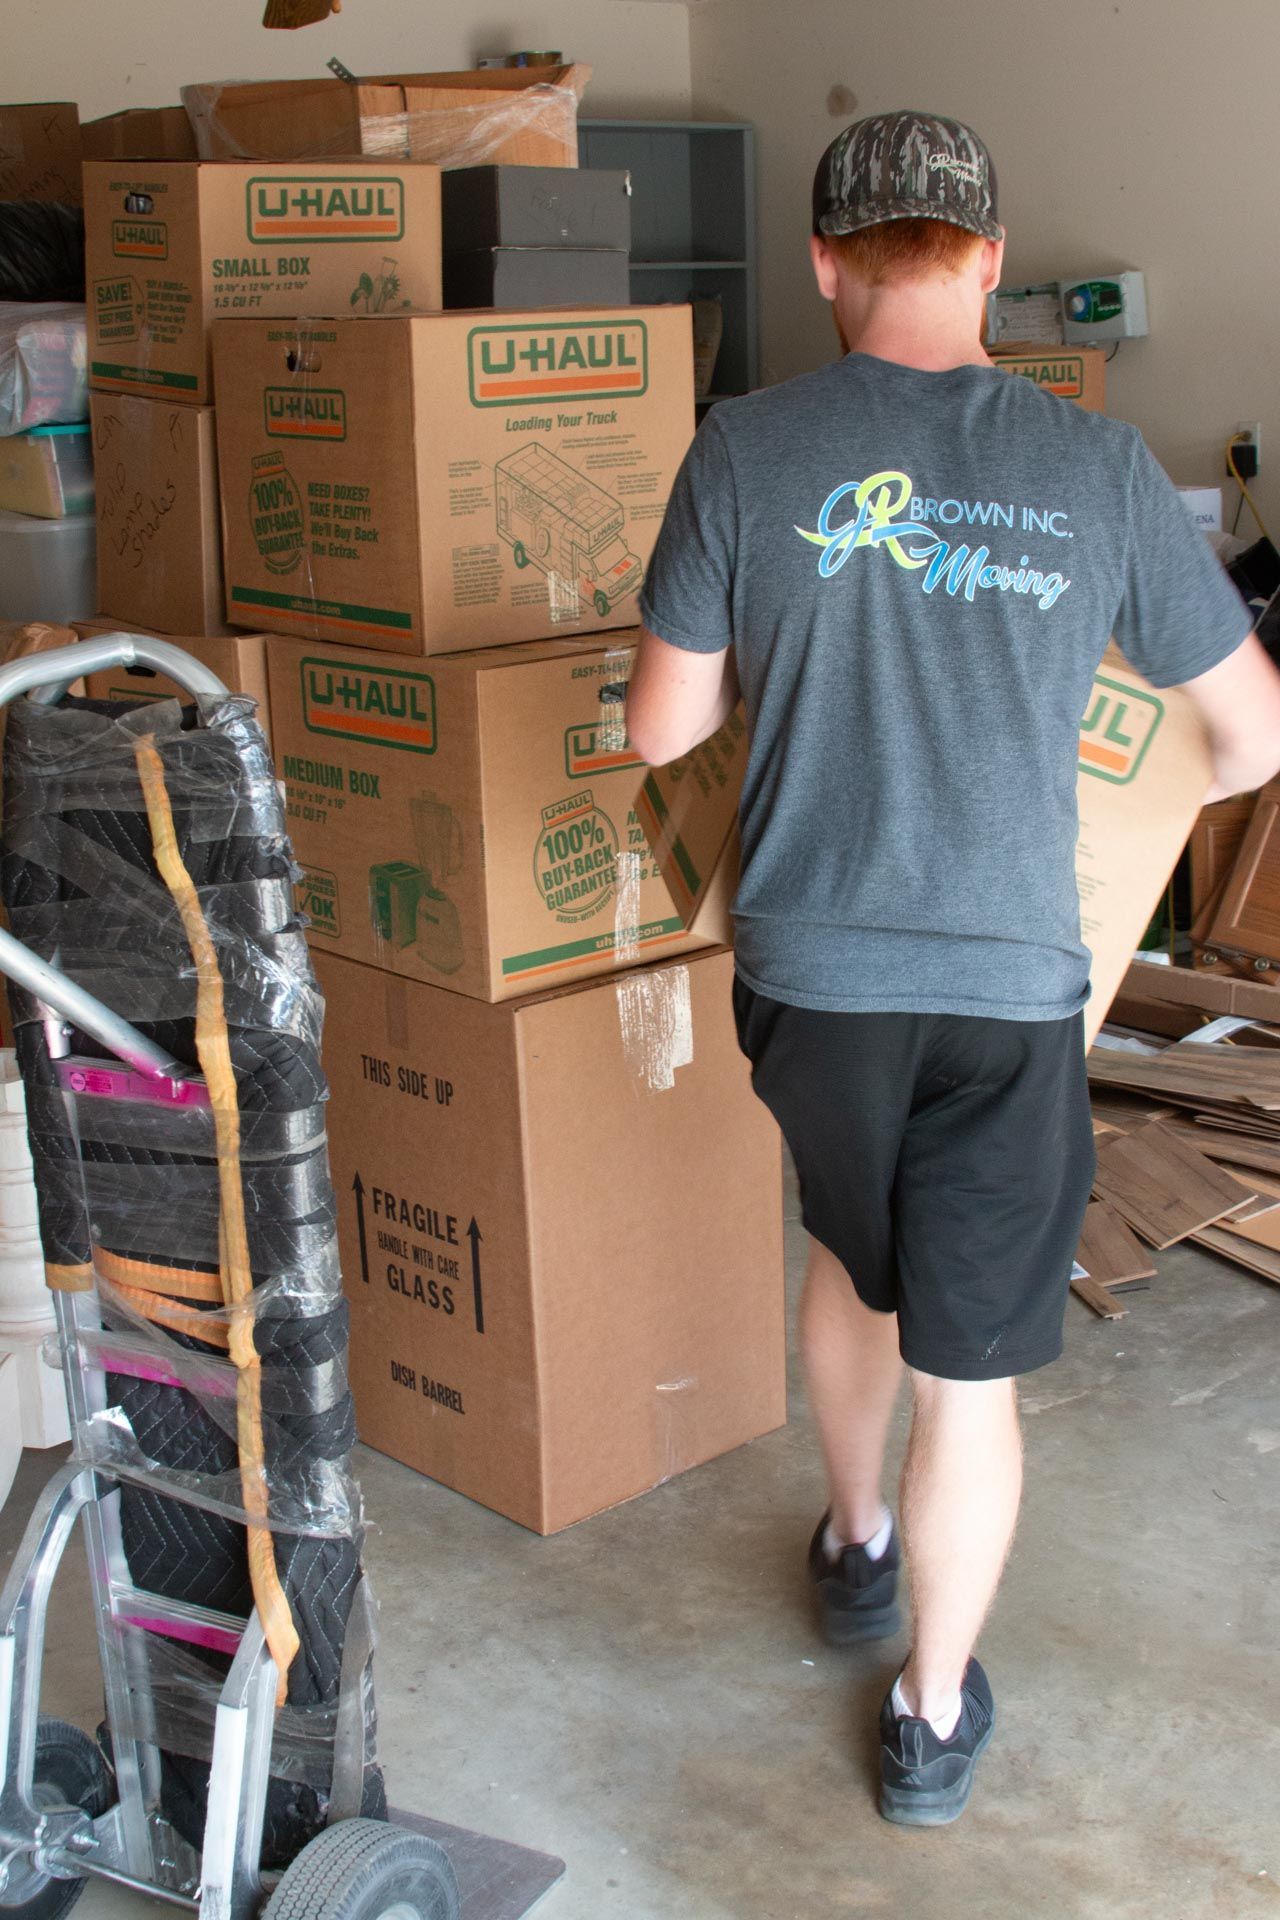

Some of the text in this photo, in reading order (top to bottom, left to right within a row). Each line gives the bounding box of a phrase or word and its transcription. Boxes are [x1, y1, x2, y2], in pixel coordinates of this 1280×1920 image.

[258, 188, 395, 217] U-HAUL
[115, 226, 164, 245] U-HAUL
[212, 257, 311, 278] SMALL BOX
[96, 282, 132, 304] SAVE!
[214, 295, 263, 308] 1.5 CU FT
[481, 334, 637, 374] U-HAUL
[270, 396, 340, 421] U-HAUL
[505, 410, 618, 432] Loading Your Truck
[254, 479, 294, 512] 100%
[308, 482, 370, 502] NEED BOXES?
[256, 509, 303, 536] BUY-BACK
[310, 502, 371, 522] TAKE PLENTY!
[910, 497, 1074, 538] BROWN INC.
[311, 522, 379, 543] We'll Buy Back
[329, 543, 361, 560] Extras.
[909, 540, 1071, 610] Moving
[310, 671, 427, 721] U-HAUL
[283, 756, 382, 800] MEDIUM BOX
[287, 803, 300, 817] 3.0
[316, 810, 327, 824] FT
[545, 795, 590, 821] U-HAUL
[543, 815, 605, 865] 100%
[542, 844, 614, 891] BUY-BACK
[546, 865, 617, 911] GUARANTEE
[311, 895, 337, 920] OK
[361, 1054, 454, 1106] THIS SIDE UP
[372, 1186, 459, 1246] FRAGILE
[378, 1230, 460, 1281] HANDLE WITH CARE
[387, 1263, 455, 1316] GLASS
[391, 1359, 465, 1415] DISH BARREL
